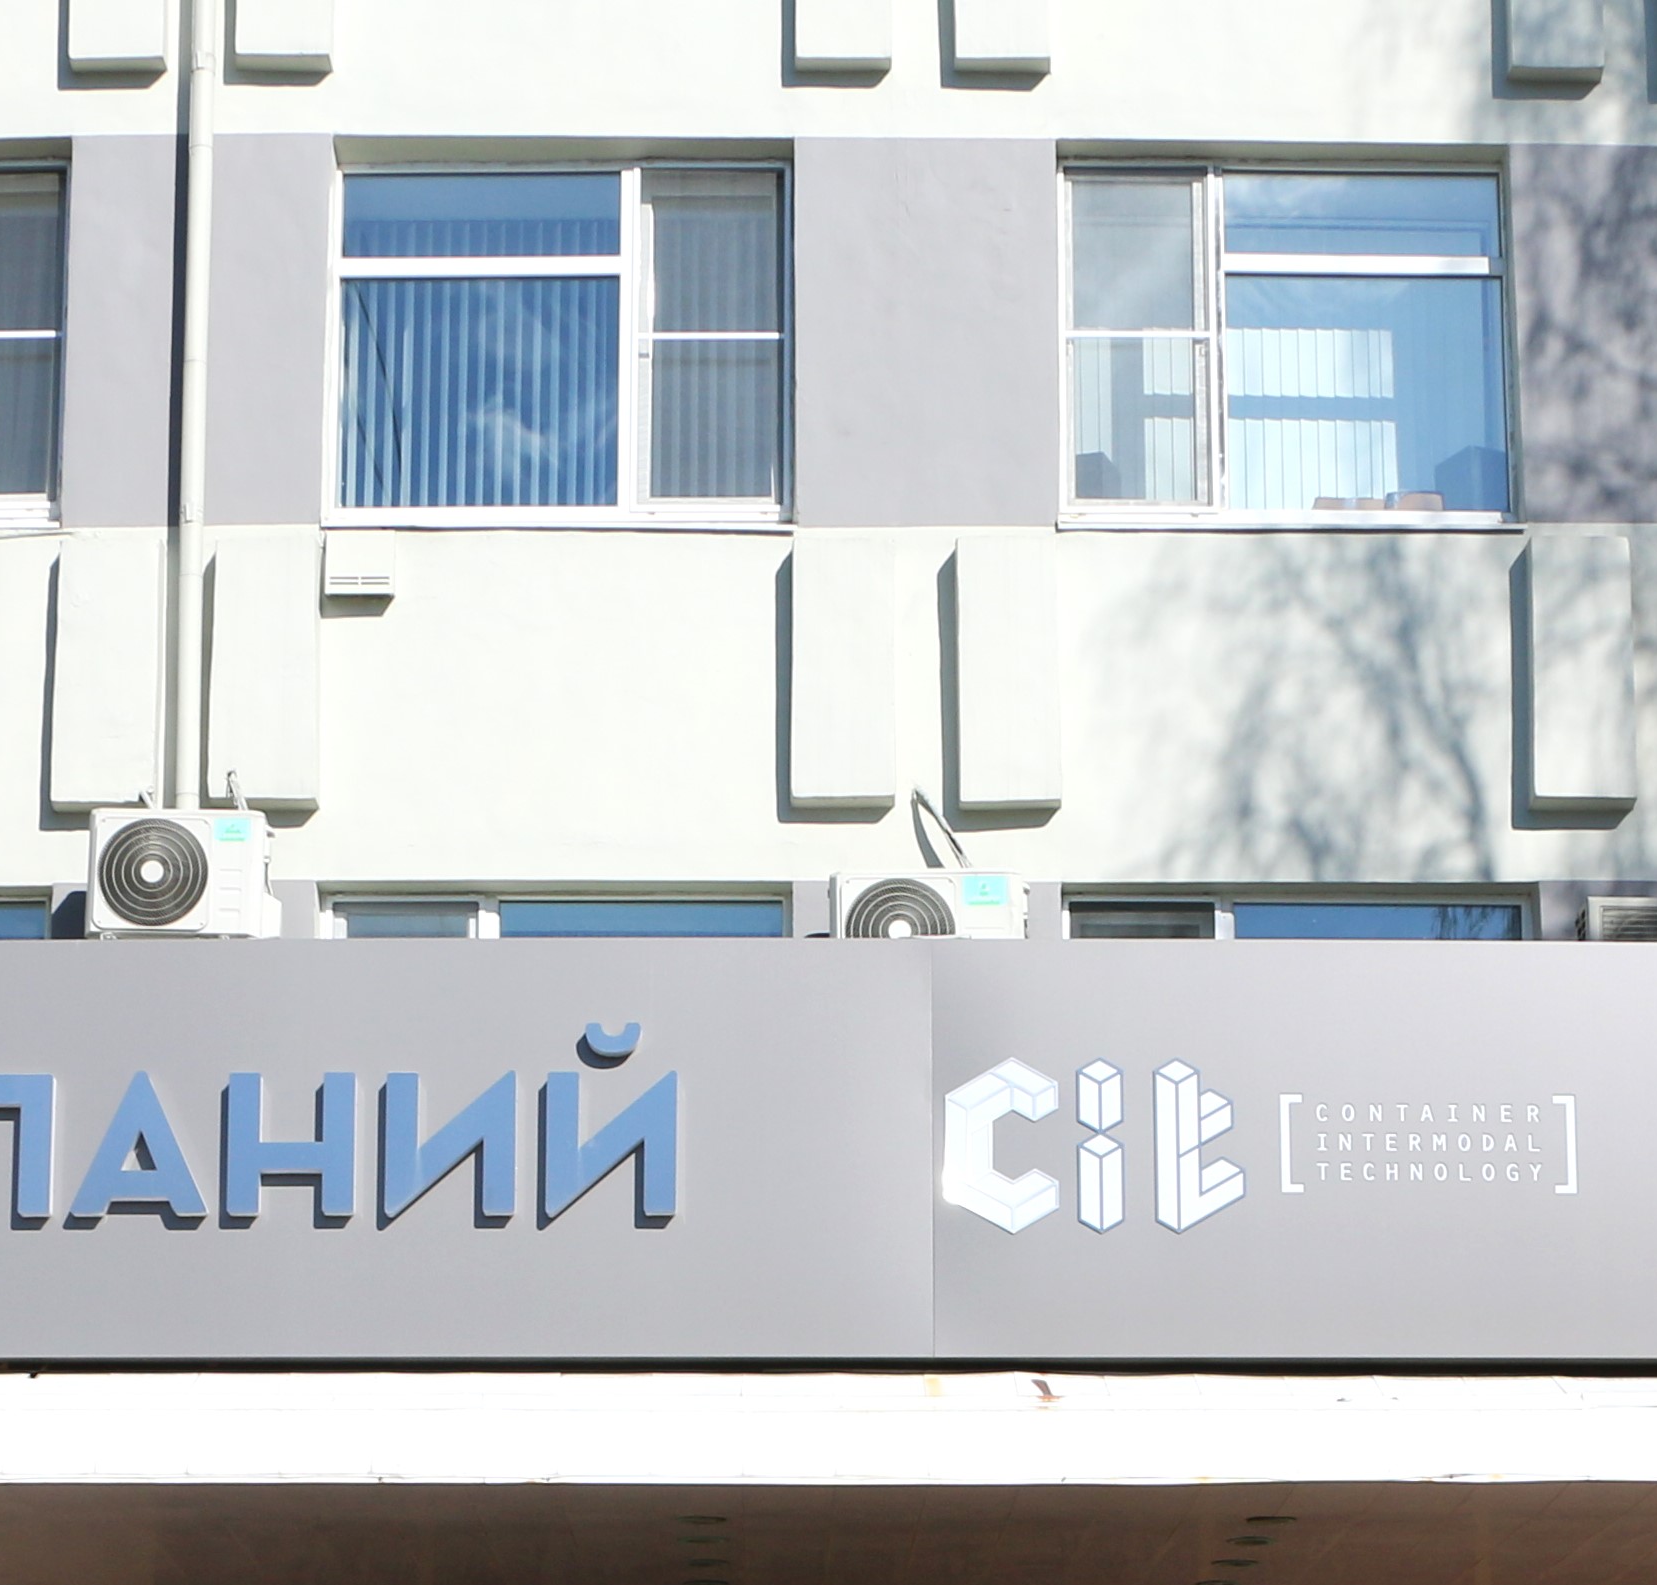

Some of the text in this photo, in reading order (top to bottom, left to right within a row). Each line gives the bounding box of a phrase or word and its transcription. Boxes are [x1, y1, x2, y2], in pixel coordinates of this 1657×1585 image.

[1315, 1103, 1542, 1124] CONTAINER
[1316, 1132, 1543, 1153] INTERMODAL
[1316, 1162, 1545, 1183] TECHNOLOGY
